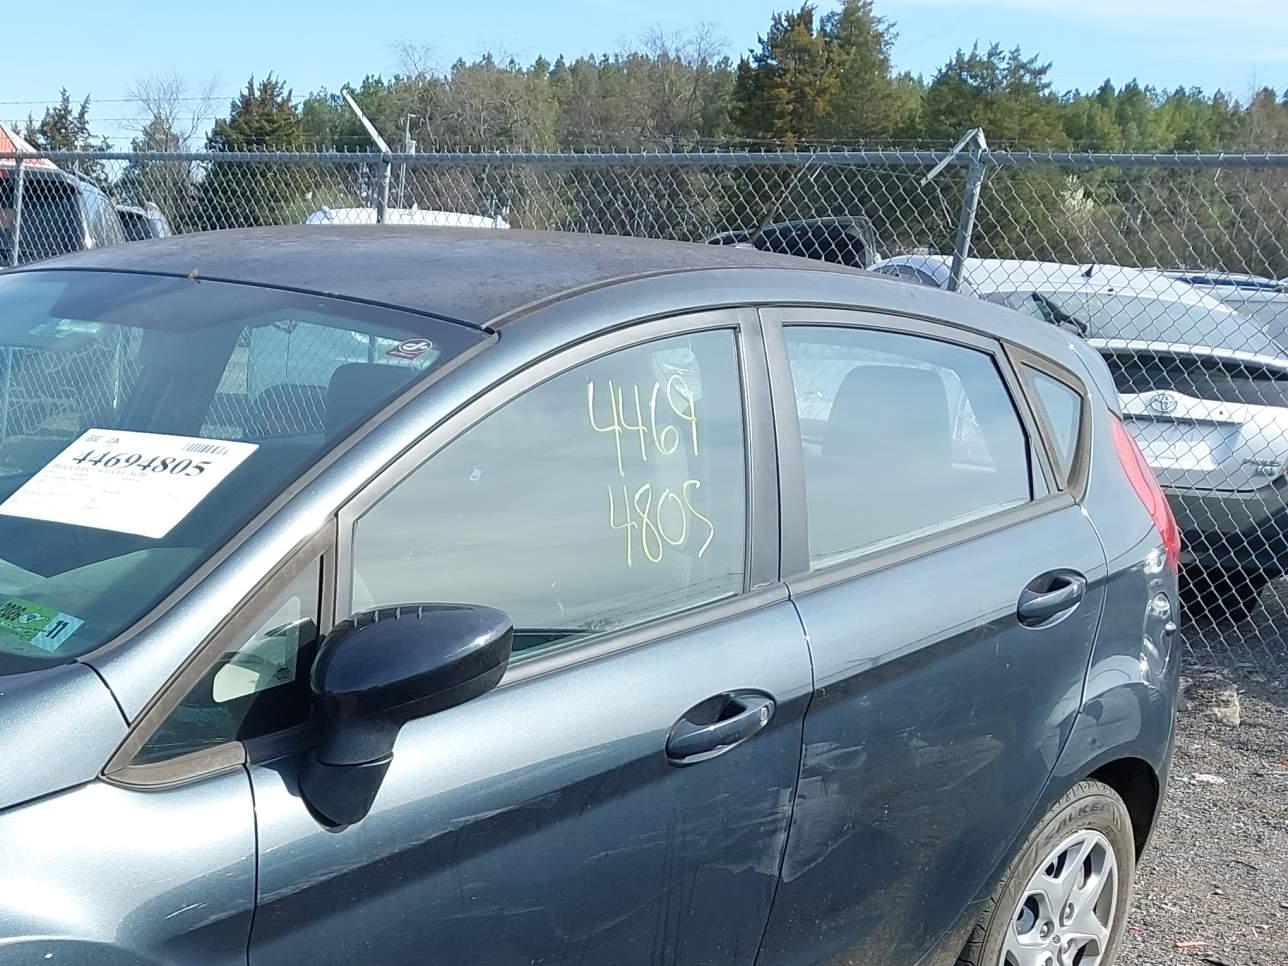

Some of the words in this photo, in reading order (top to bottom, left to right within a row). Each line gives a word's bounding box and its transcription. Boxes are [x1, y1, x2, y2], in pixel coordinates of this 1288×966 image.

[586, 374, 699, 477] 4469
[72, 449, 213, 477] 44694805
[608, 479, 714, 567] 4805
[45, 619, 69, 640] 11
